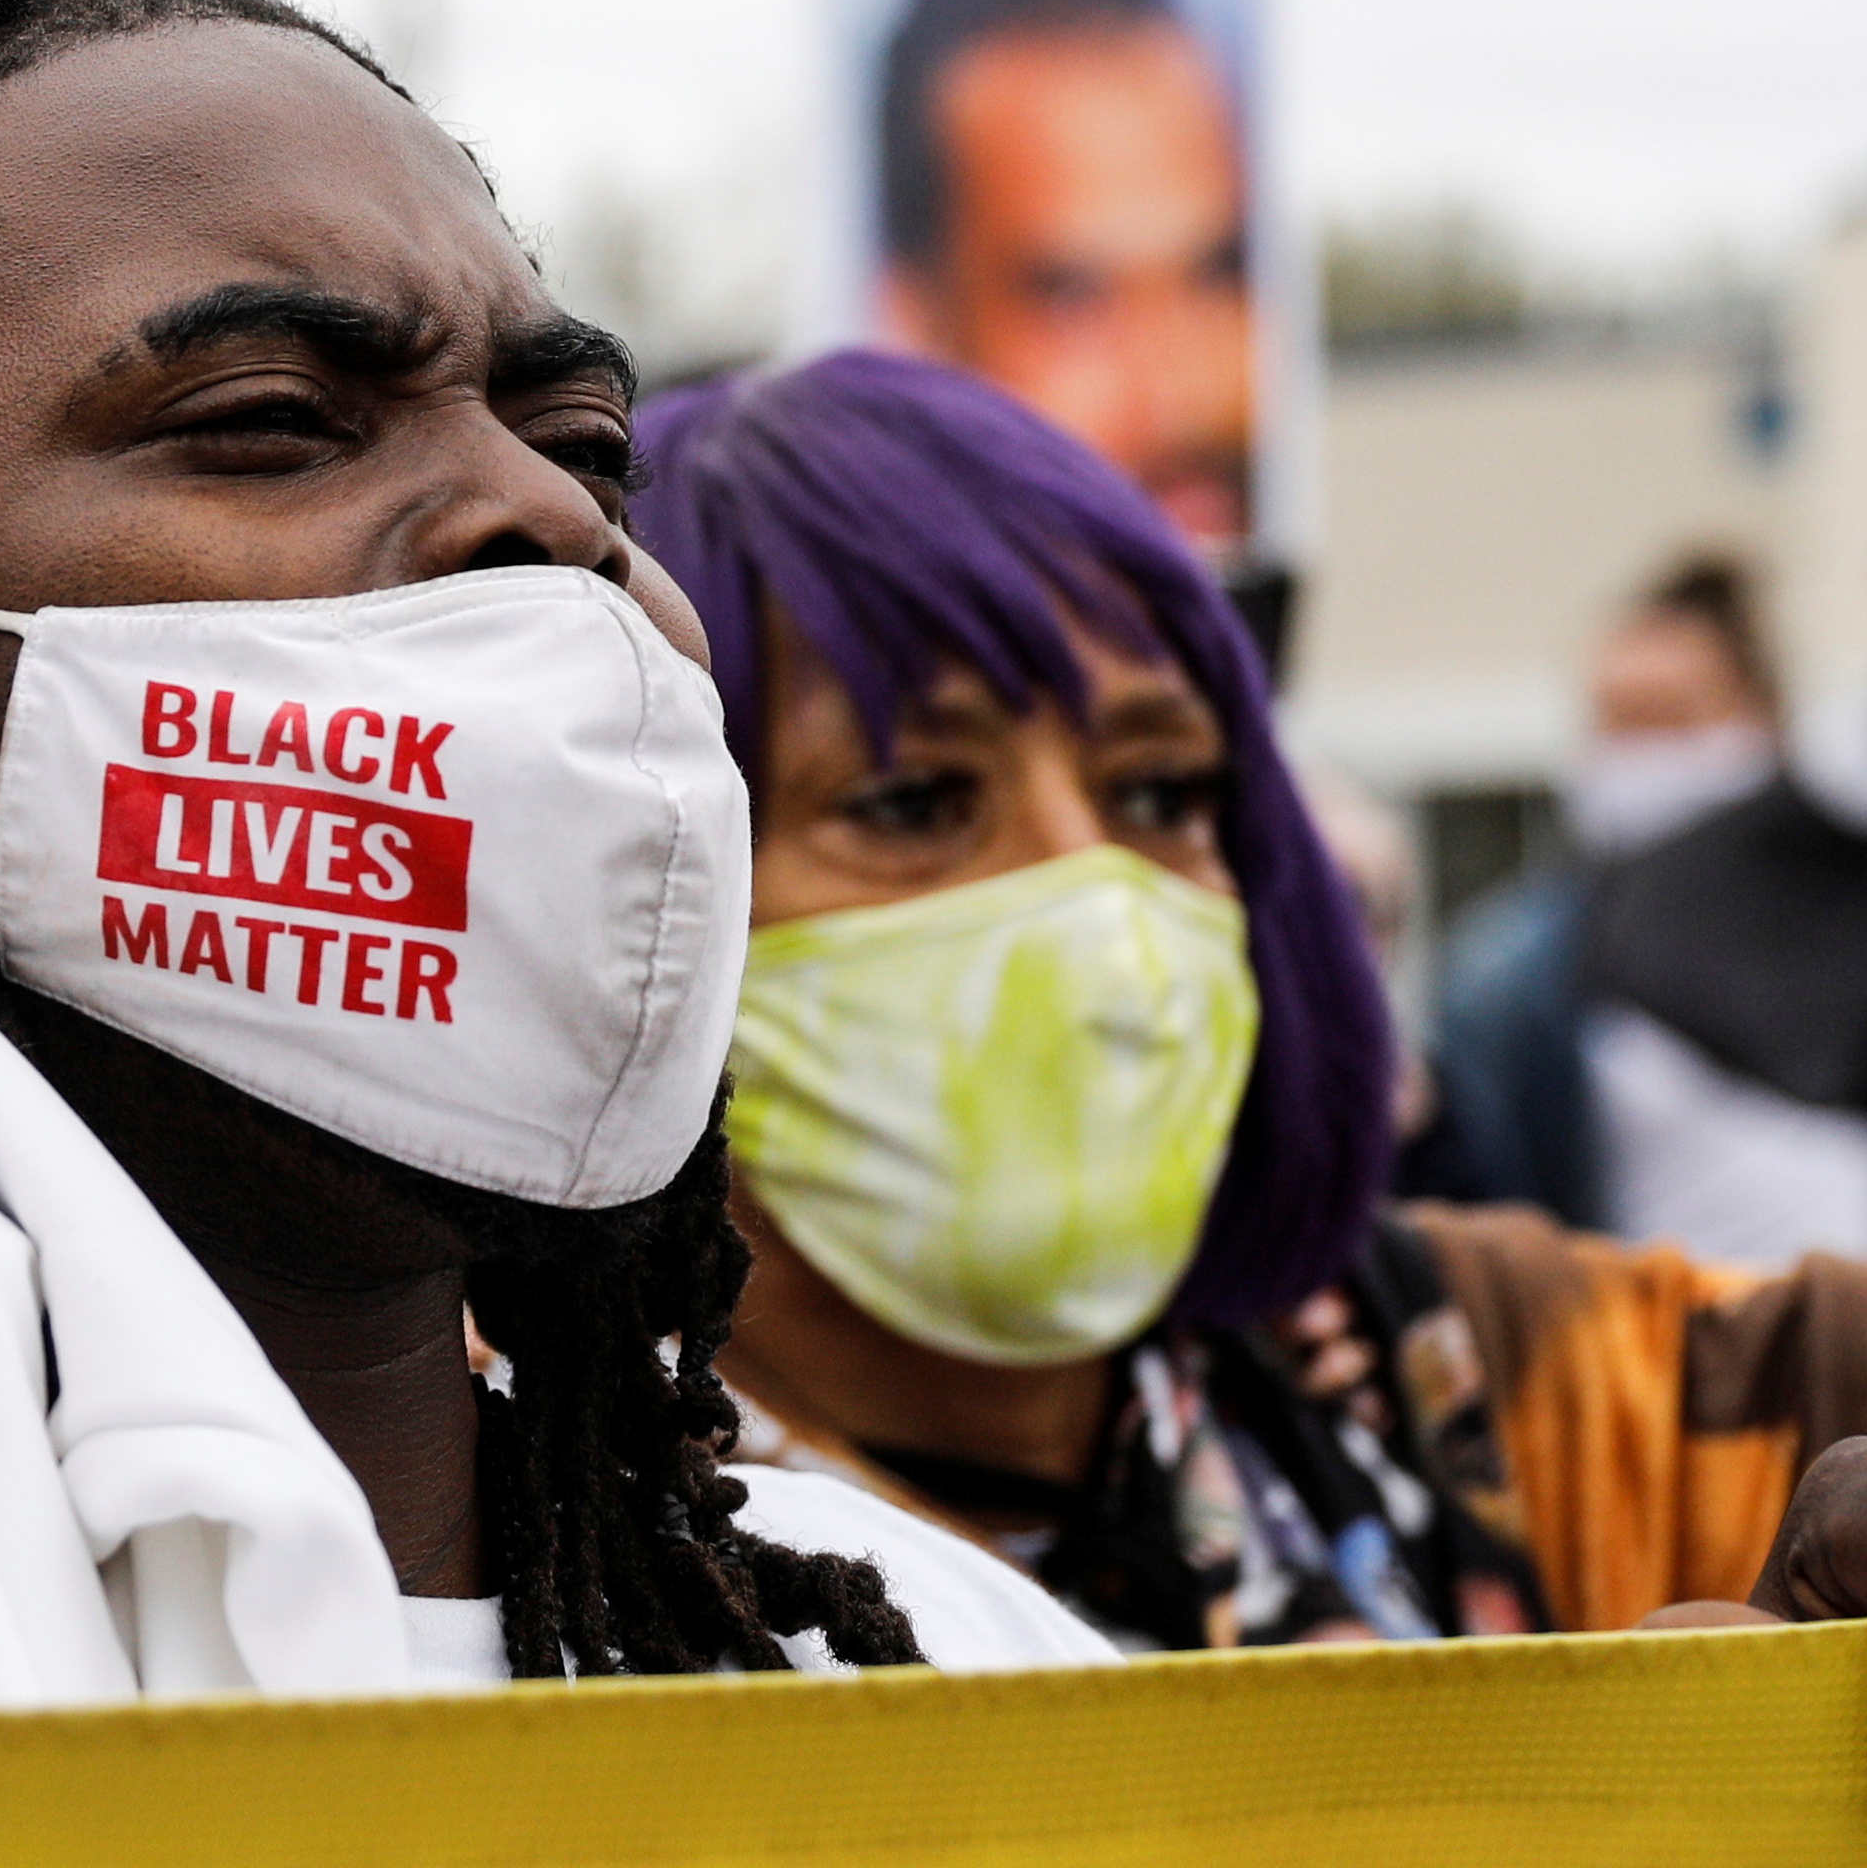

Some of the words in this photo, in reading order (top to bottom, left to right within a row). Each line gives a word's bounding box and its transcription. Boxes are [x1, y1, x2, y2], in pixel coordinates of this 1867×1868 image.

[142, 681, 455, 800] BLACK
[156, 794, 413, 900] LIVES
[103, 896, 458, 1024] MATTER
